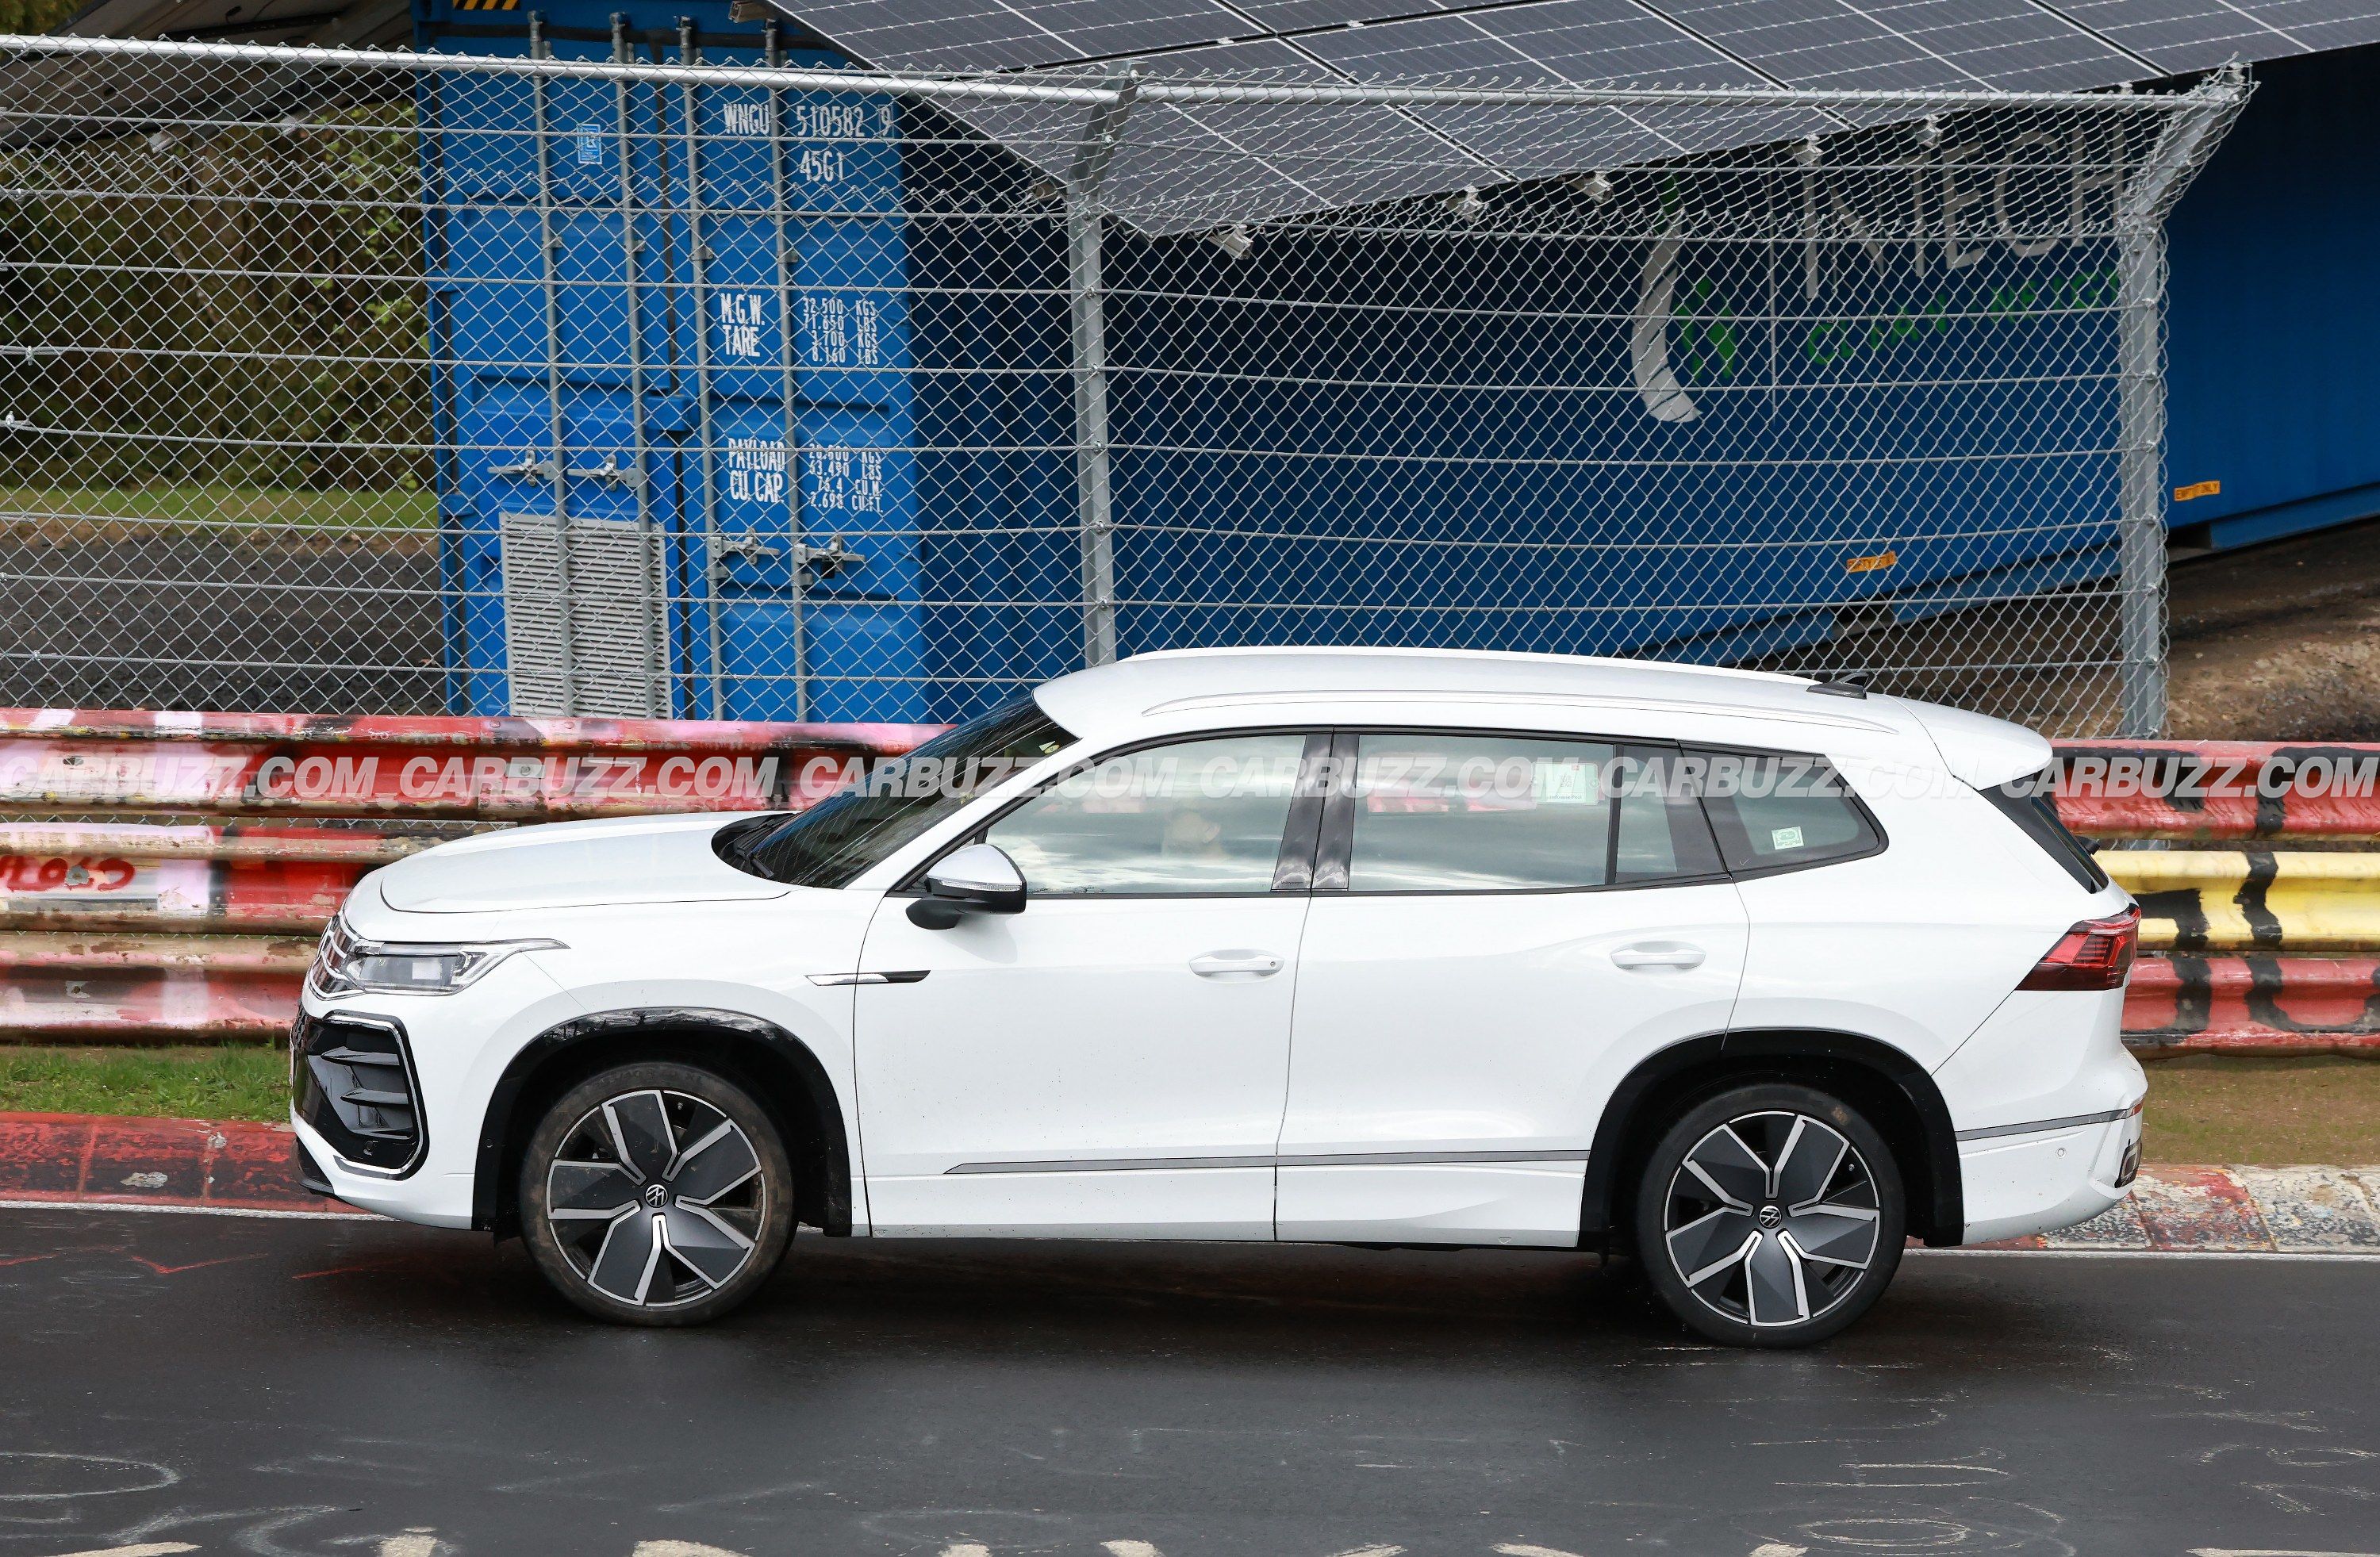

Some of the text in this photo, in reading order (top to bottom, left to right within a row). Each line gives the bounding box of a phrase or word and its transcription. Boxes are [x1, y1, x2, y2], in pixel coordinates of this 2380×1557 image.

[724, 104, 770, 135] WNGU
[797, 105, 865, 137] 510582
[800, 151, 843, 182] 45G1
[856, 300, 877, 317] KGS
[857, 316, 877, 333] LBS
[723, 325, 760, 357] TARE
[858, 332, 878, 350] KGS
[858, 347, 879, 366] LBS
[727, 438, 785, 471] PAYLOAD
